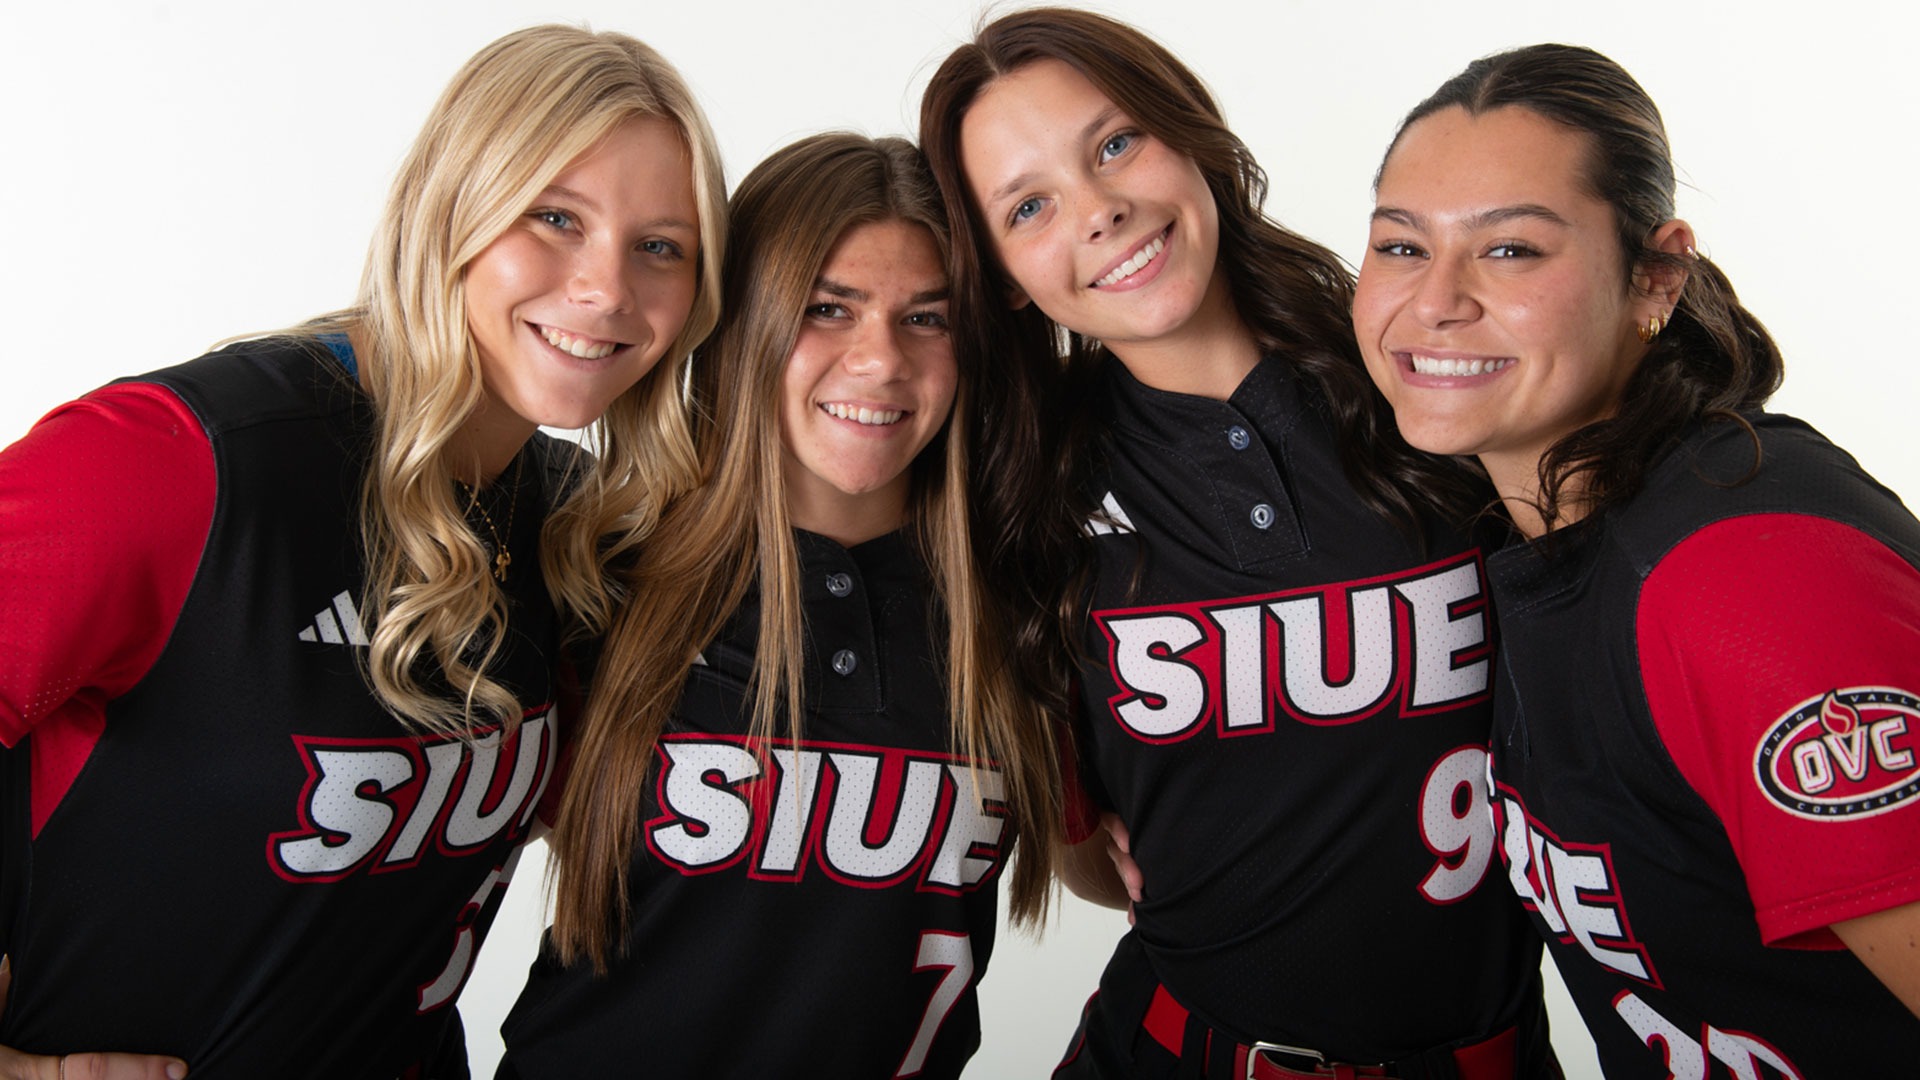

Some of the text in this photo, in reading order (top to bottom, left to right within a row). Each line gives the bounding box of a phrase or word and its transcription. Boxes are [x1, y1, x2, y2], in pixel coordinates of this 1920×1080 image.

[1097, 553, 1494, 742] SIUE
[270, 702, 558, 880] SIU
[1763, 711, 1805, 757] OHIO
[1791, 715, 1916, 795] OVC
[647, 735, 1006, 893] SIUE
[1418, 745, 1496, 903] 9
[895, 929, 975, 1080] 7
